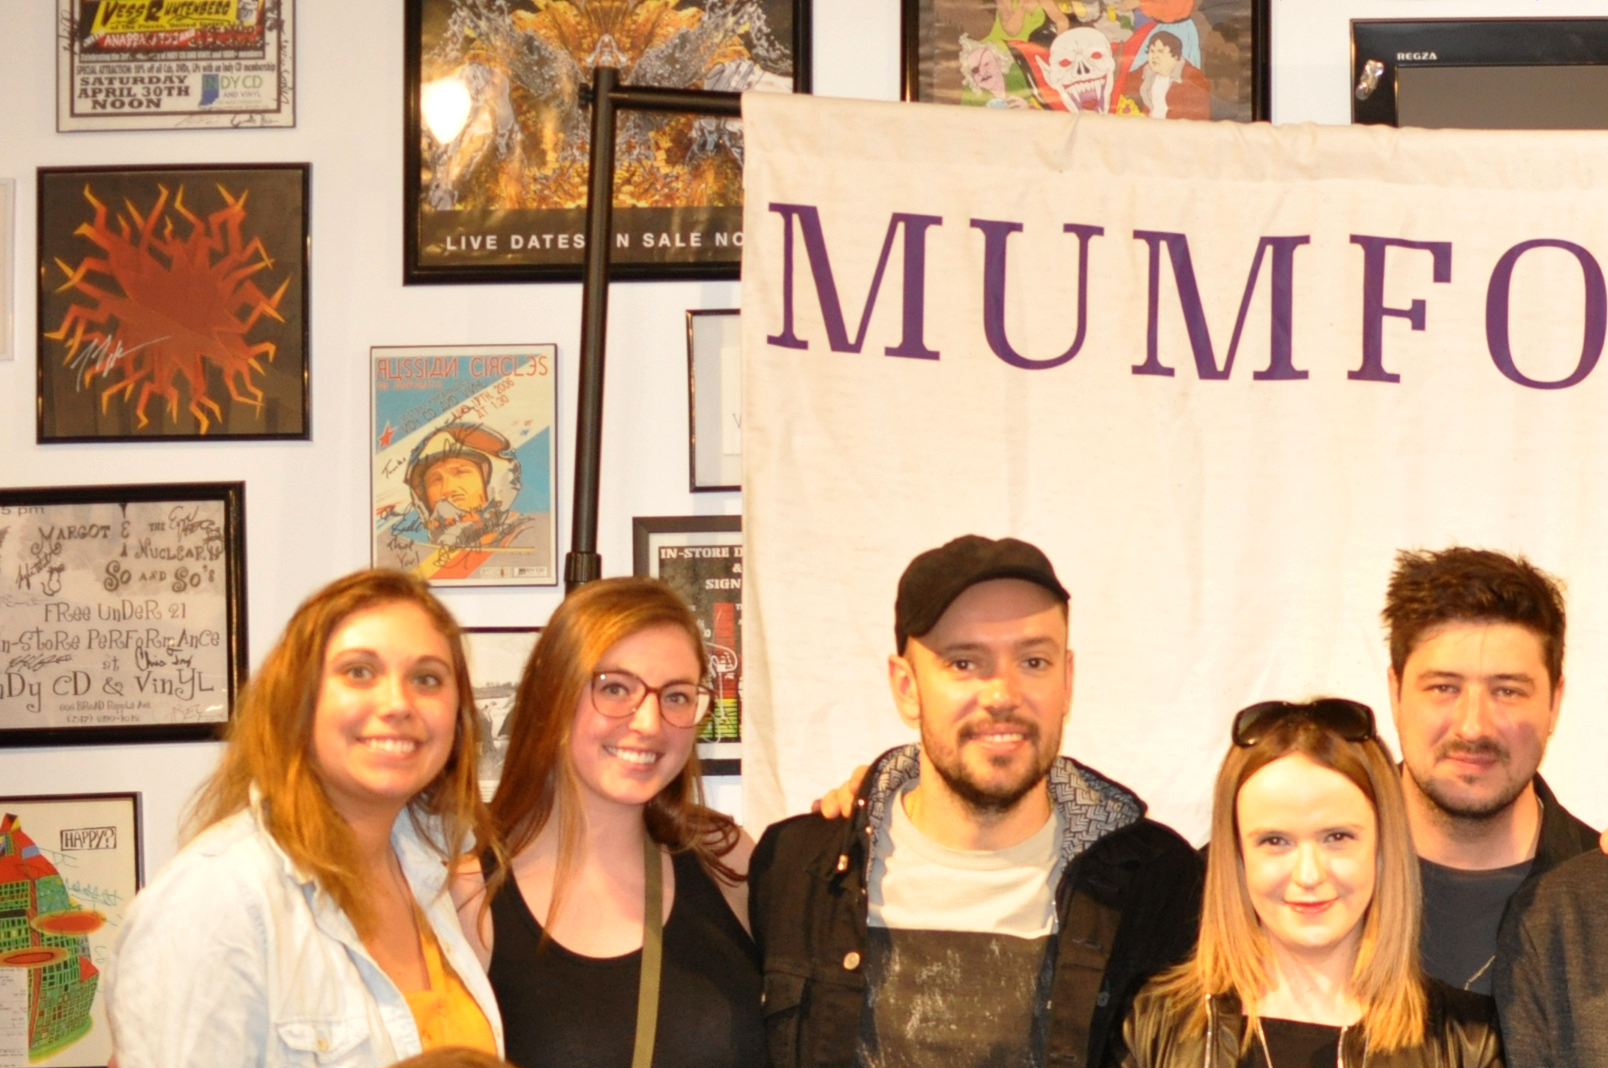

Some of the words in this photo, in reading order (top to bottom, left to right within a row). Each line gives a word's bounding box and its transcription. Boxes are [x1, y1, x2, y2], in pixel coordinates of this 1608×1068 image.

[101, 0, 146, 27] VESS
[1396, 52, 1438, 61] REGZA
[80, 75, 188, 87] SATURDAY
[242, 75, 263, 88] CD
[78, 87, 137, 99] APRIL
[142, 86, 190, 97] 30TH
[91, 98, 162, 110] NOON
[446, 234, 498, 251] LIVE
[510, 234, 586, 250] DATES
[642, 232, 702, 248] SALE
[17, 506, 45, 517] pm
[31, 523, 111, 556] MARGOT
[660, 547, 729, 559] IN-STORE
[139, 570, 167, 582] AND
[168, 602, 187, 620] 21
[52, 670, 91, 696] CD
[102, 677, 124, 697] &
[64, 827, 116, 849] HAPPY?
